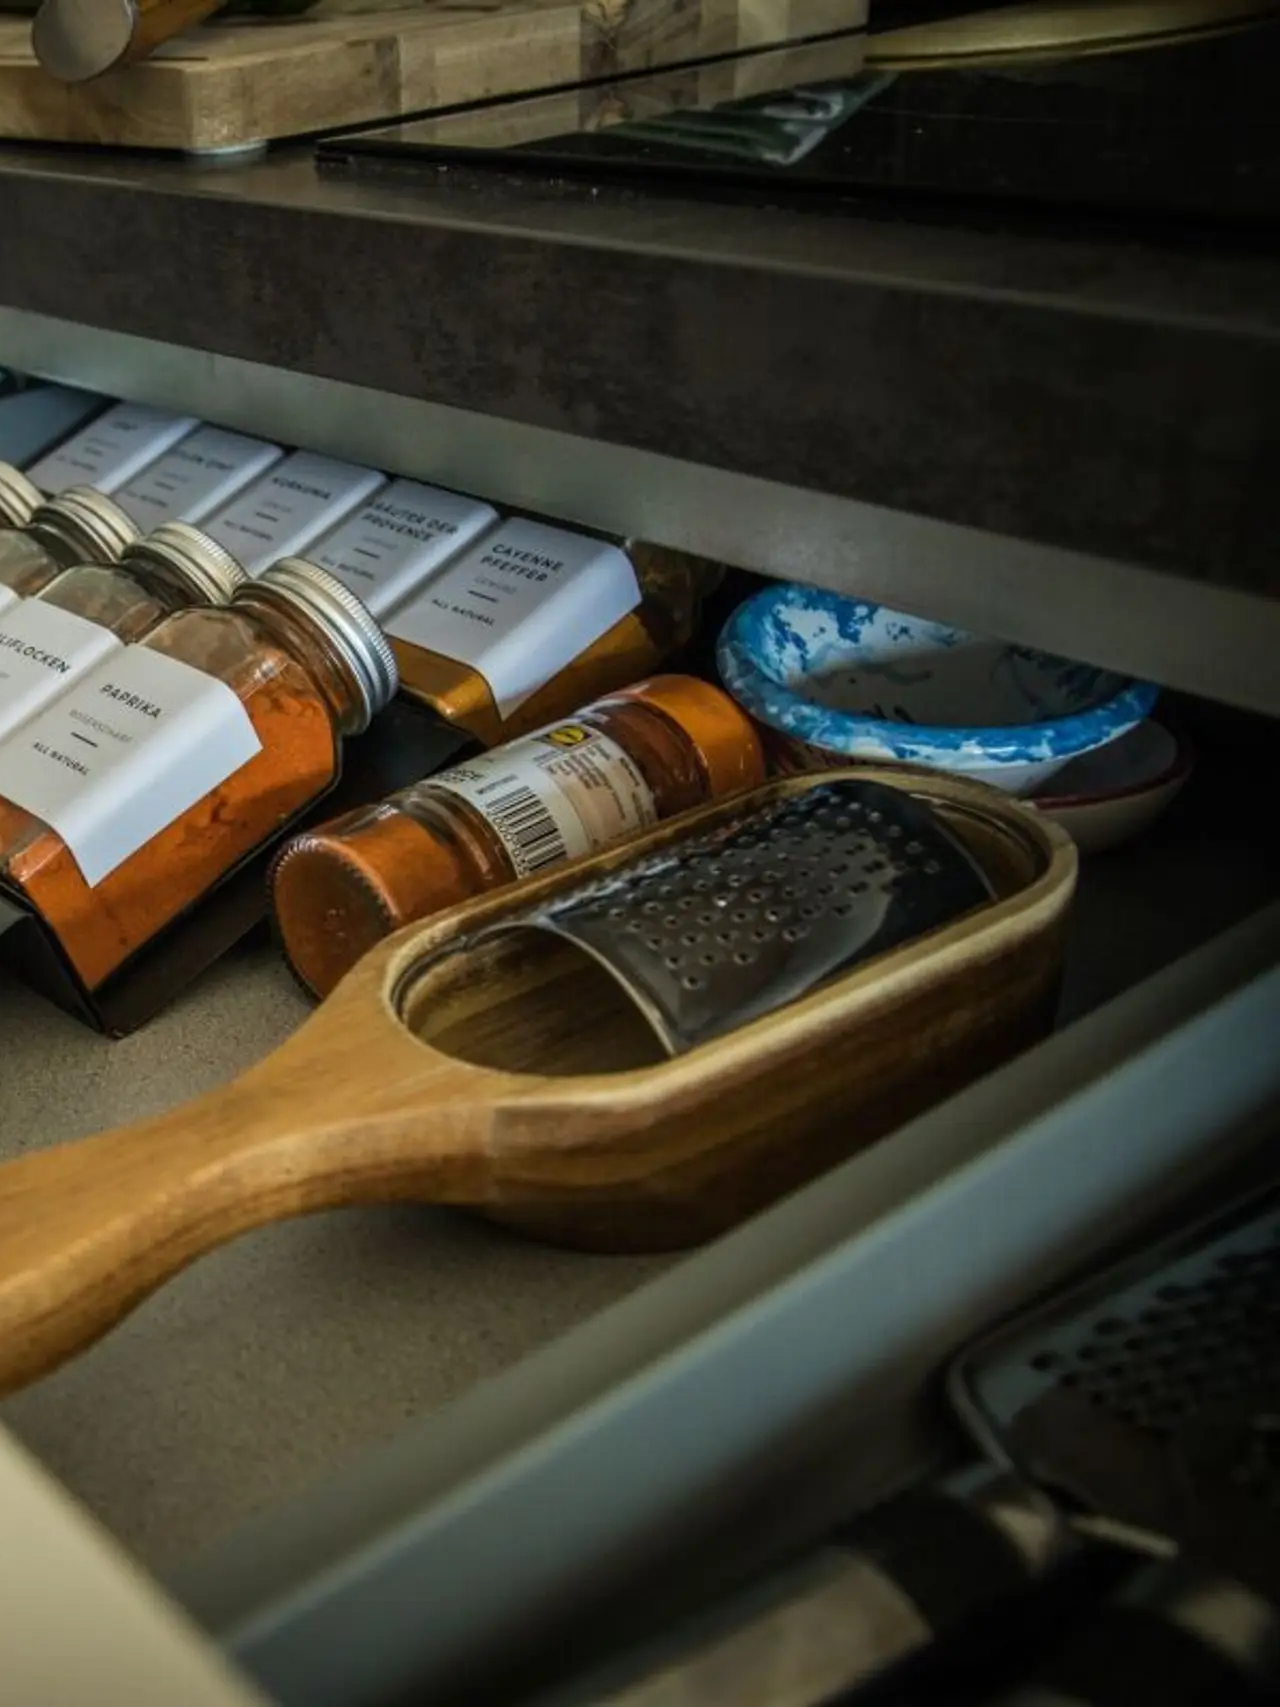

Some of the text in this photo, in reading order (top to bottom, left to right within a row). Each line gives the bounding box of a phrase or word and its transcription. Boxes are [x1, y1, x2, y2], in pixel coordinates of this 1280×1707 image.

[480, 555, 549, 582] PFEFFER
[492, 543, 565, 572] CAYENNE
[432, 598, 496, 627] ALL NATURAL
[99, 683, 162, 719] PAPRIKA
[32, 742, 91, 776] ALL NATURAL
